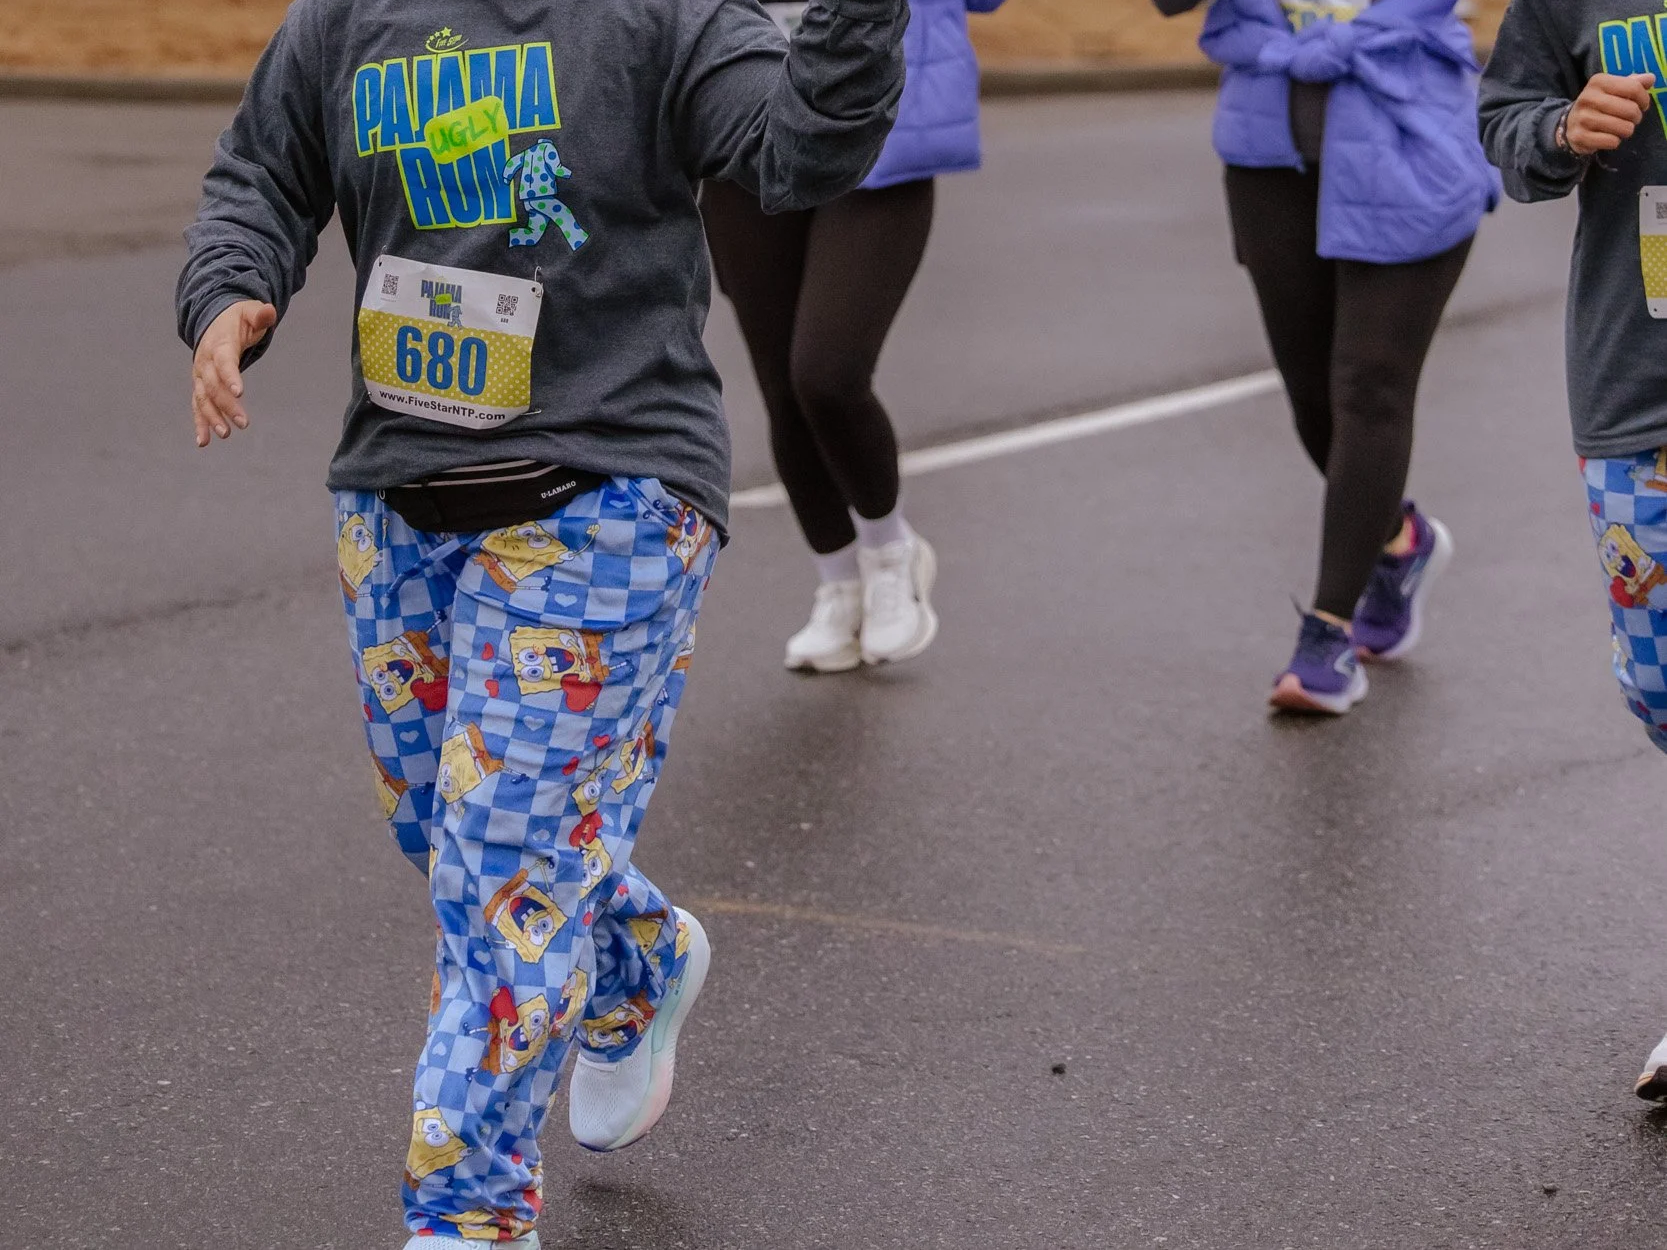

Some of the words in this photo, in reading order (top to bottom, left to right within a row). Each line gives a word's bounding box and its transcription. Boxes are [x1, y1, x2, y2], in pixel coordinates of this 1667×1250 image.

[352, 41, 561, 157] PAJAMA
[430, 102, 501, 156] UGLY
[396, 138, 518, 230] RUN
[420, 279, 463, 304] PAJAMA
[396, 325, 488, 396] 680
[379, 389, 506, 421] www.FiveStarNTP.com
